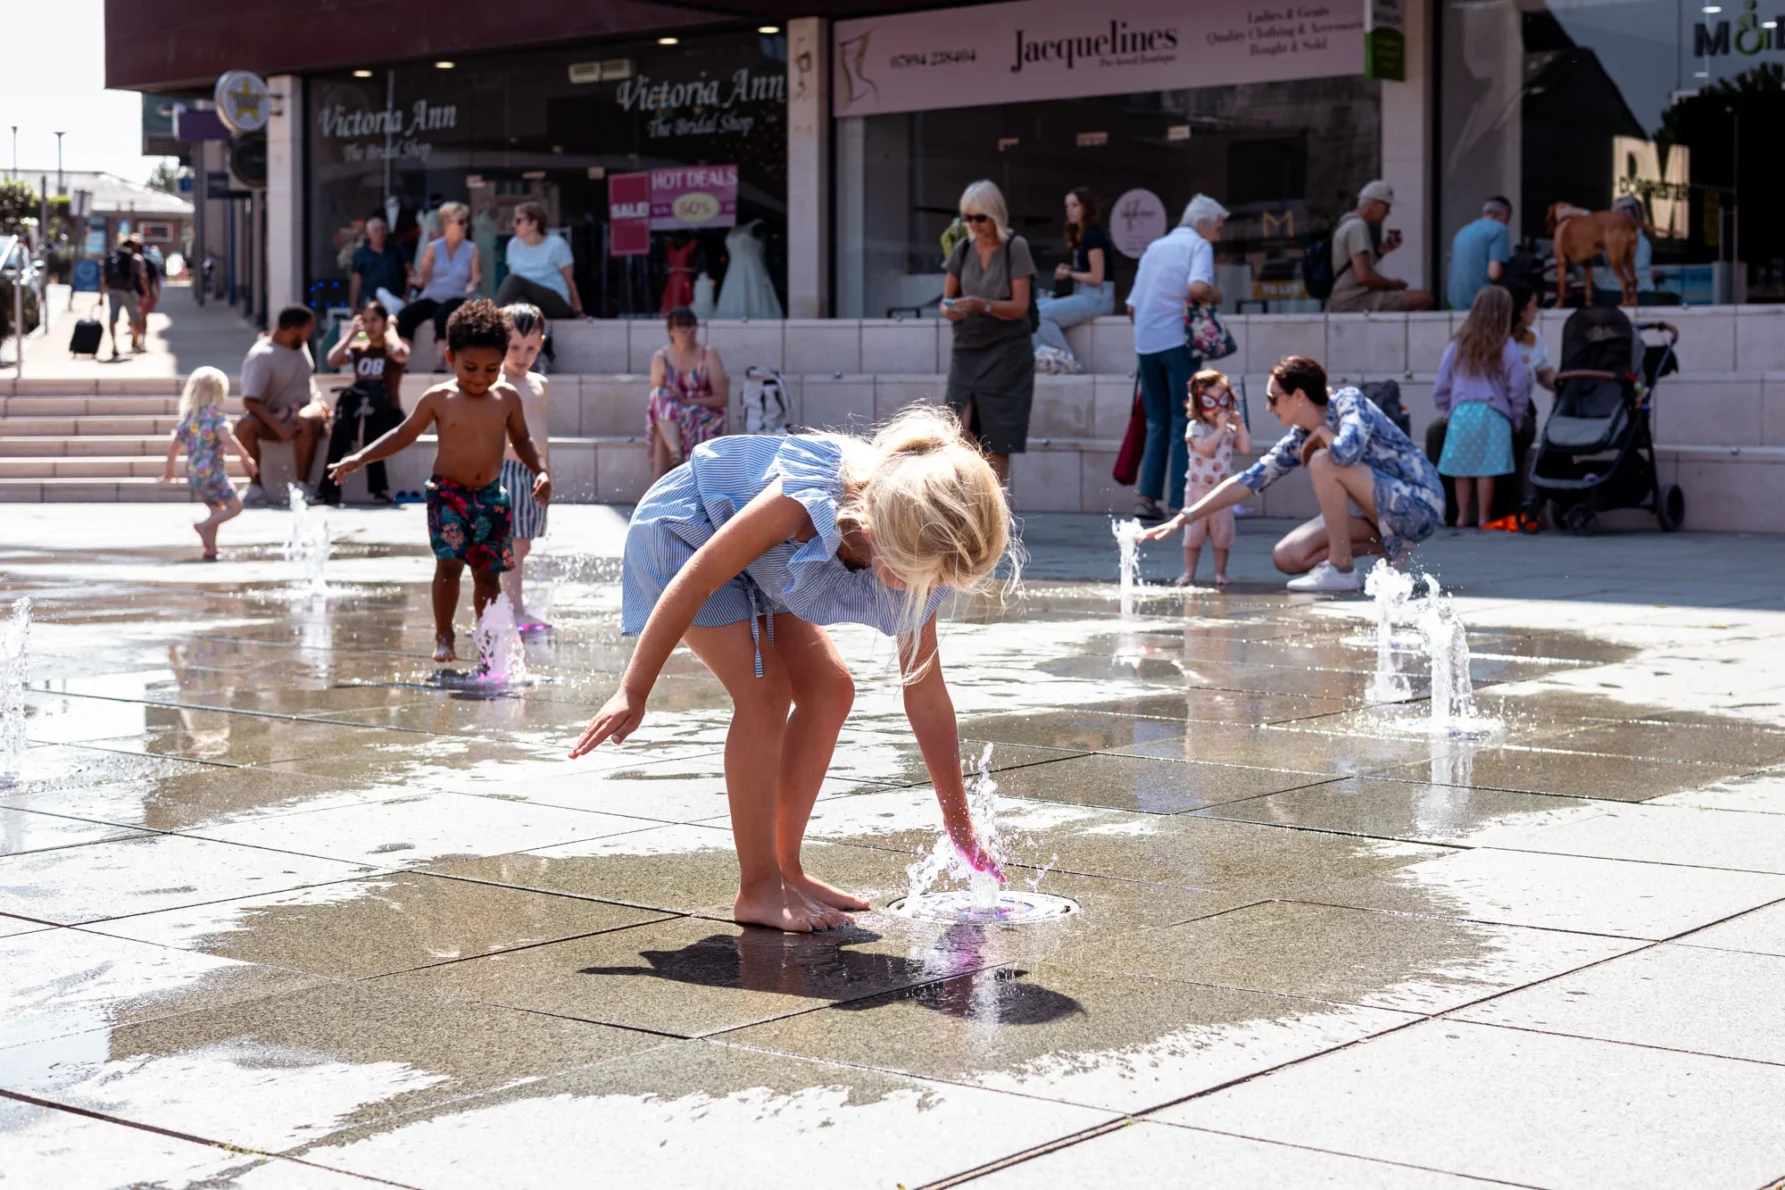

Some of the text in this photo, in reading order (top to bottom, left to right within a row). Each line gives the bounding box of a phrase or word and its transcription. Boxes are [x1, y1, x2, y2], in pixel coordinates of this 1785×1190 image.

[1010, 19, 1178, 73] Jacquelines
[616, 67, 785, 111] Victoria Ann
[317, 98, 457, 137] Victoria Ann
[646, 110, 755, 138] The Bridal Shop
[652, 168, 738, 190] HOT DEALS
[358, 357, 385, 376] 08
